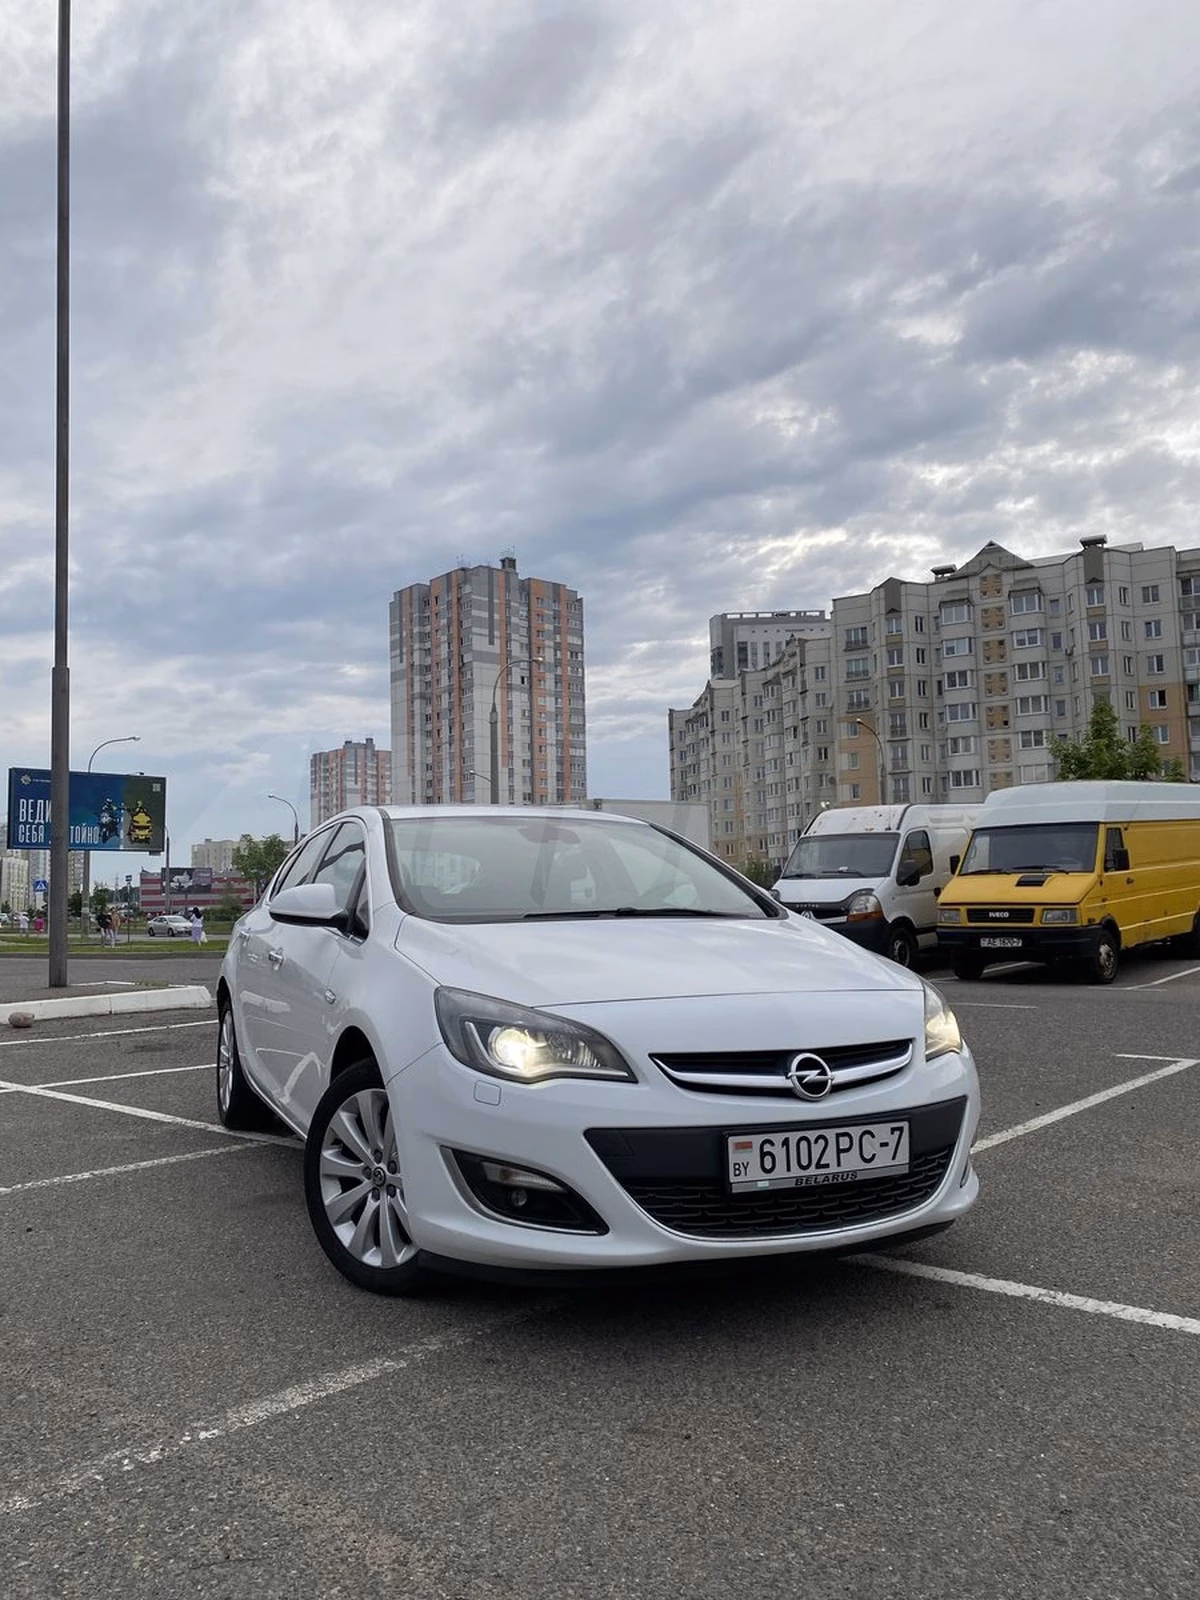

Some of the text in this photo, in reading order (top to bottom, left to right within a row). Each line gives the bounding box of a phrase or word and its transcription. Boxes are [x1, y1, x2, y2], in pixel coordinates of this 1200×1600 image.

[18, 823, 45, 844] СЕБЯ
[733, 1161, 750, 1177] BY
[794, 1171, 859, 1186] BELARUS
